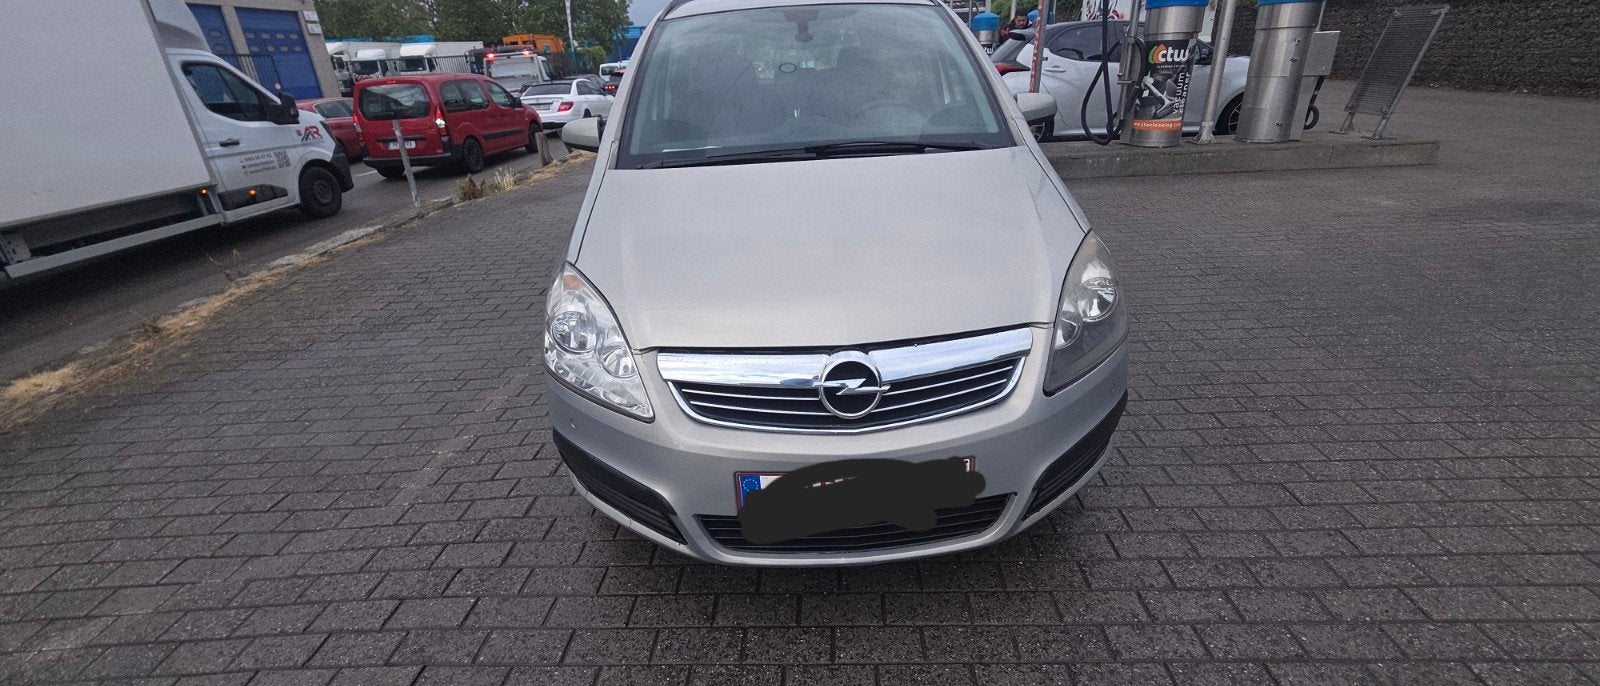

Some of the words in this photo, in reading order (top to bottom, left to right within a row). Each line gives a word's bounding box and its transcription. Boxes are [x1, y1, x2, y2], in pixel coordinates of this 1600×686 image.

[1158, 46, 1189, 62] ctw
[1173, 72, 1185, 114] vacuum
[1180, 72, 1190, 114] cleaner
